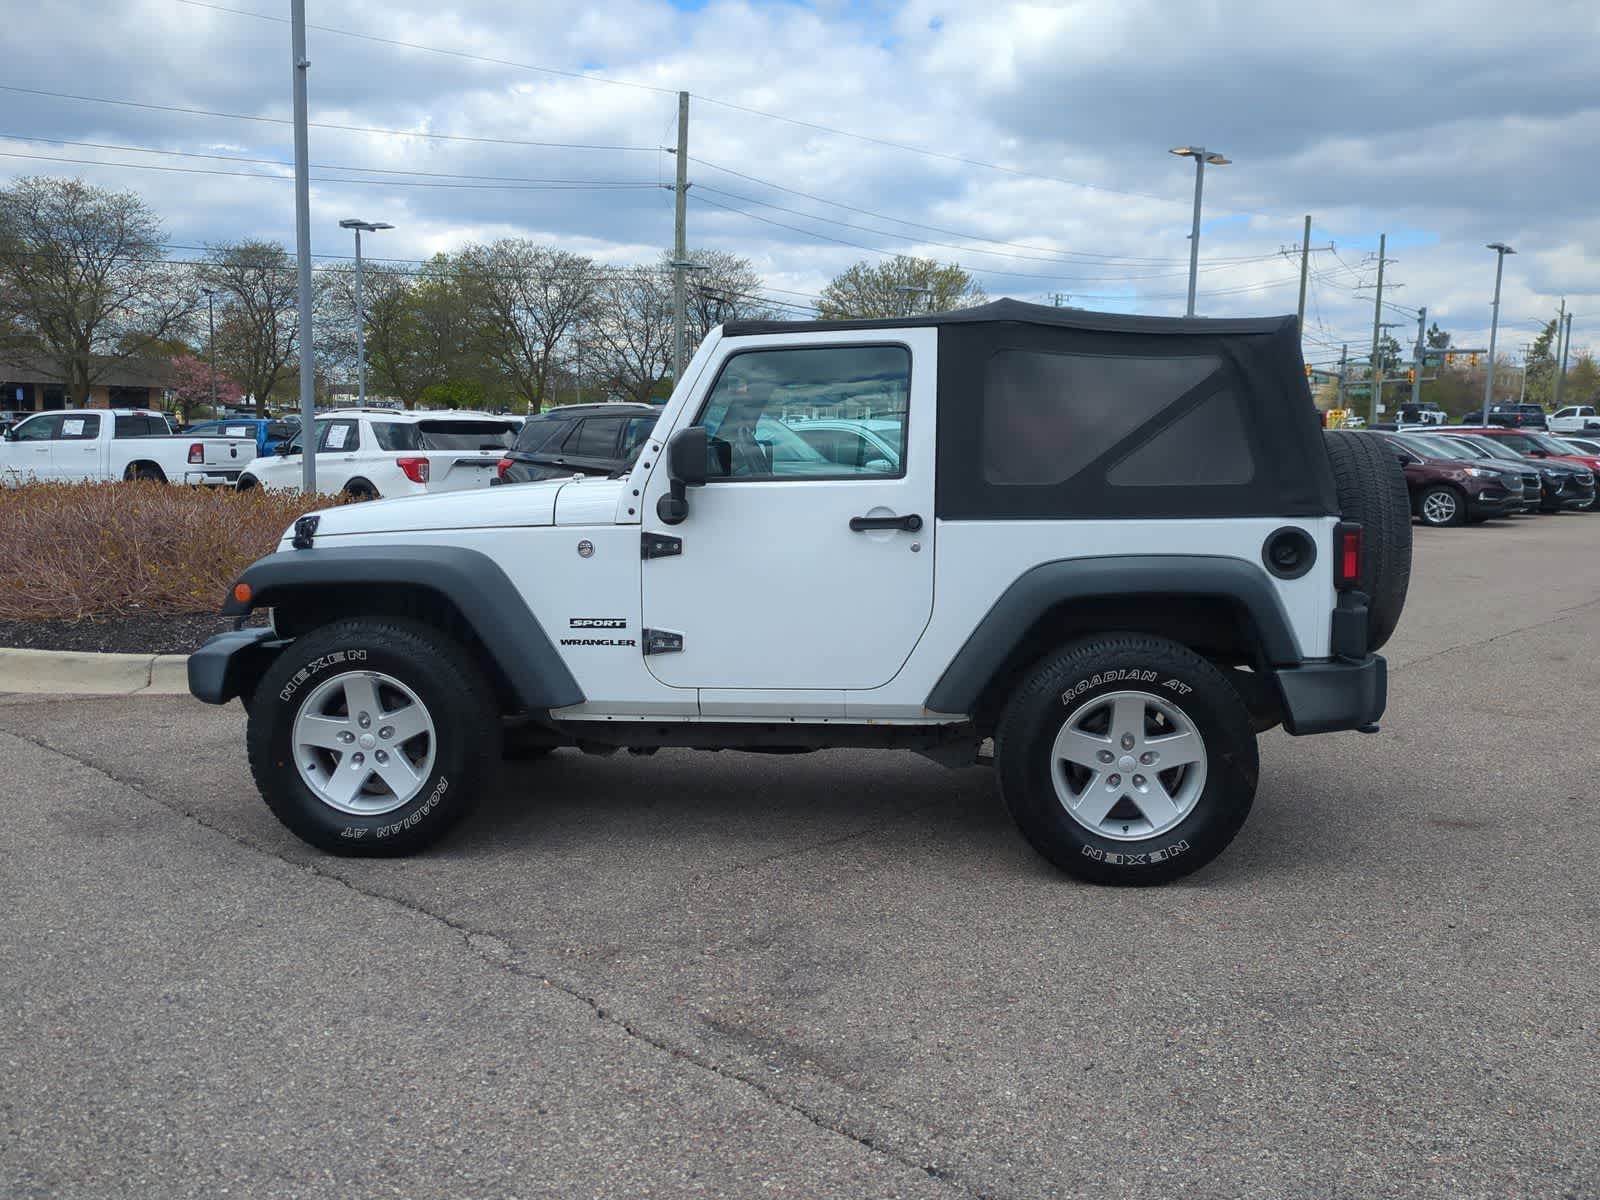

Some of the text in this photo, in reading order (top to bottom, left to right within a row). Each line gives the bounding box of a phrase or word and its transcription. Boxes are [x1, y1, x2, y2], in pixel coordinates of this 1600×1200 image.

[570, 619, 626, 628] SPORT
[560, 639, 637, 647] WRANGLER
[279, 650, 367, 702] NEXEN
[1062, 669, 1192, 705] ROADIAN AT
[340, 776, 449, 839] ROADIAN AT
[1082, 840, 1190, 865] NEXEN
